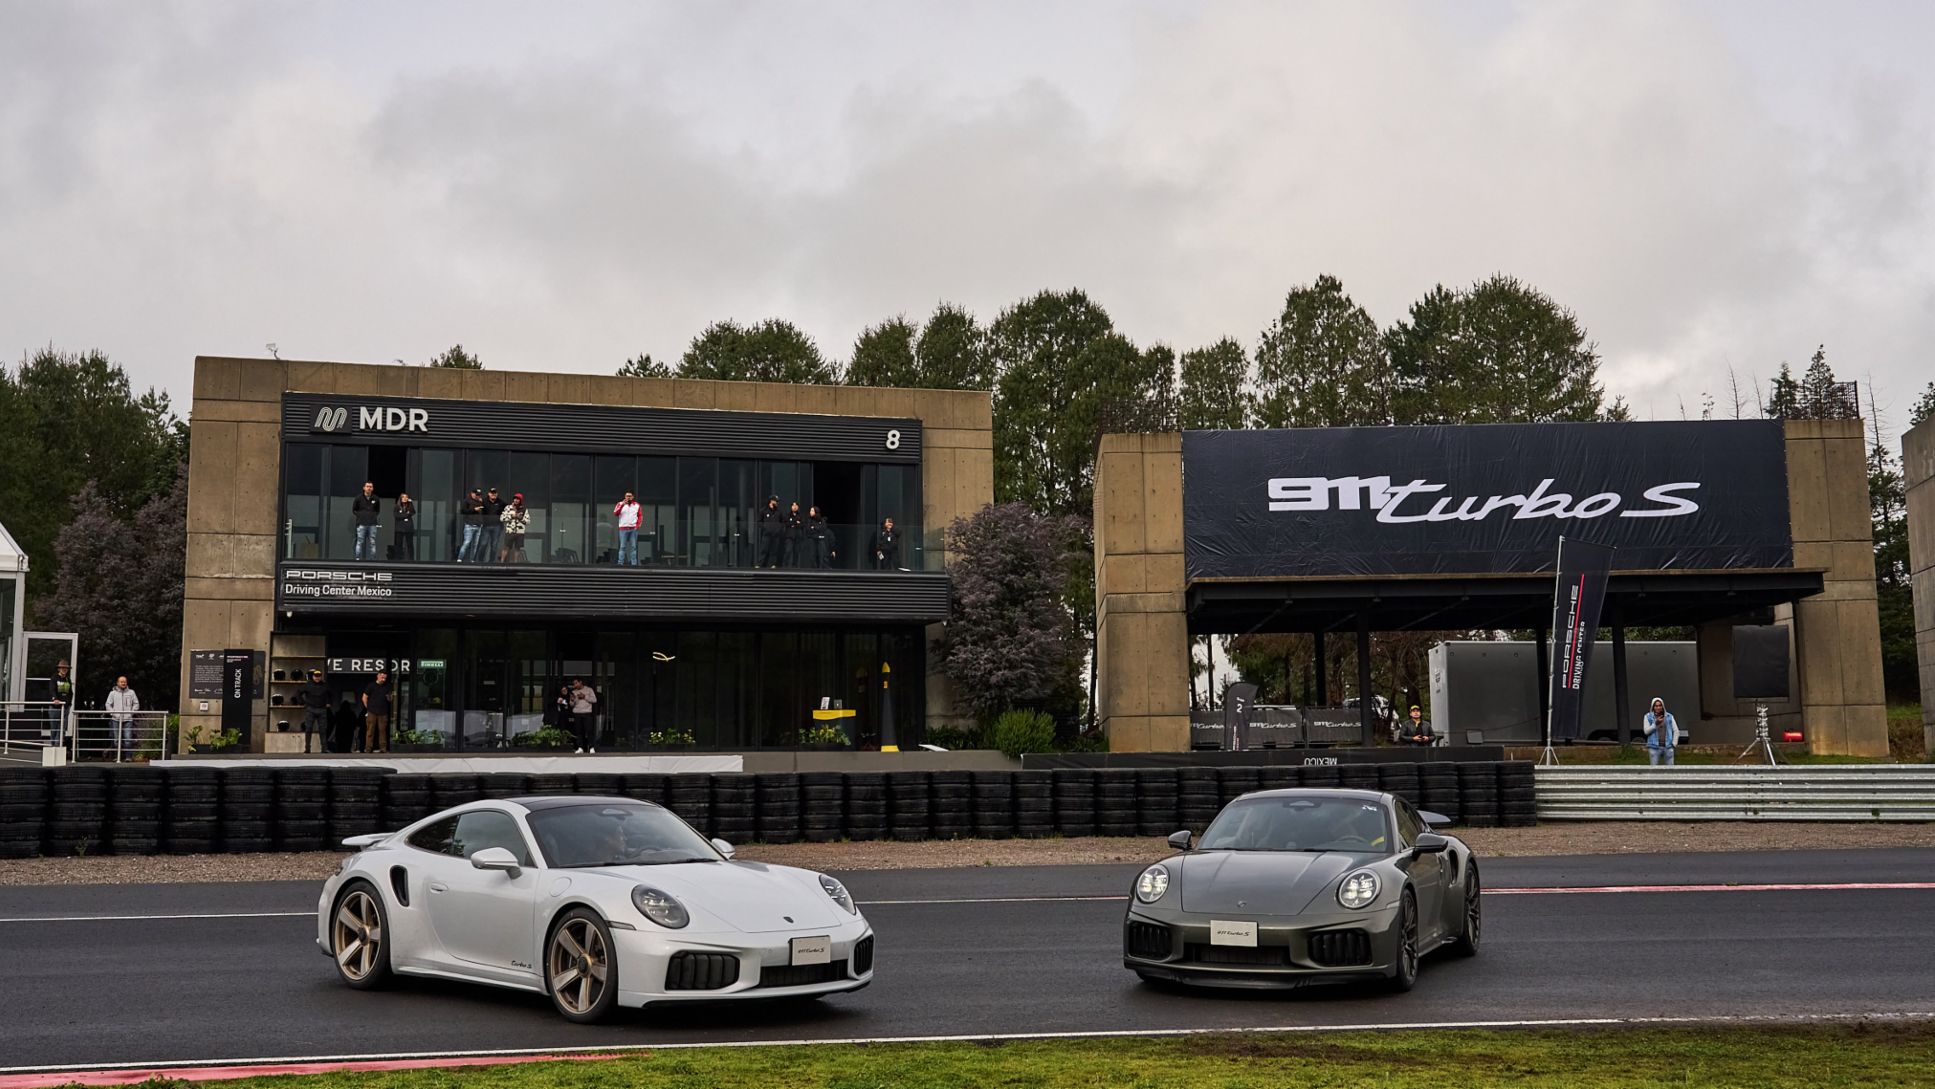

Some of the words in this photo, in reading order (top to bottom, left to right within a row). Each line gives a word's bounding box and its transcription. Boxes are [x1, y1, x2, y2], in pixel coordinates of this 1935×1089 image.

[359, 406, 429, 432] MDR
[886, 430, 900, 449] 8
[1618, 482, 1701, 517] S
[286, 570, 392, 581] PORSCHE
[285, 584, 320, 597] Driving
[322, 585, 356, 596] Center
[357, 586, 392, 597] Mexico
[1562, 584, 1579, 689] PORSCHE
[234, 668, 242, 688] TRACK
[234, 688, 241, 699] ON
